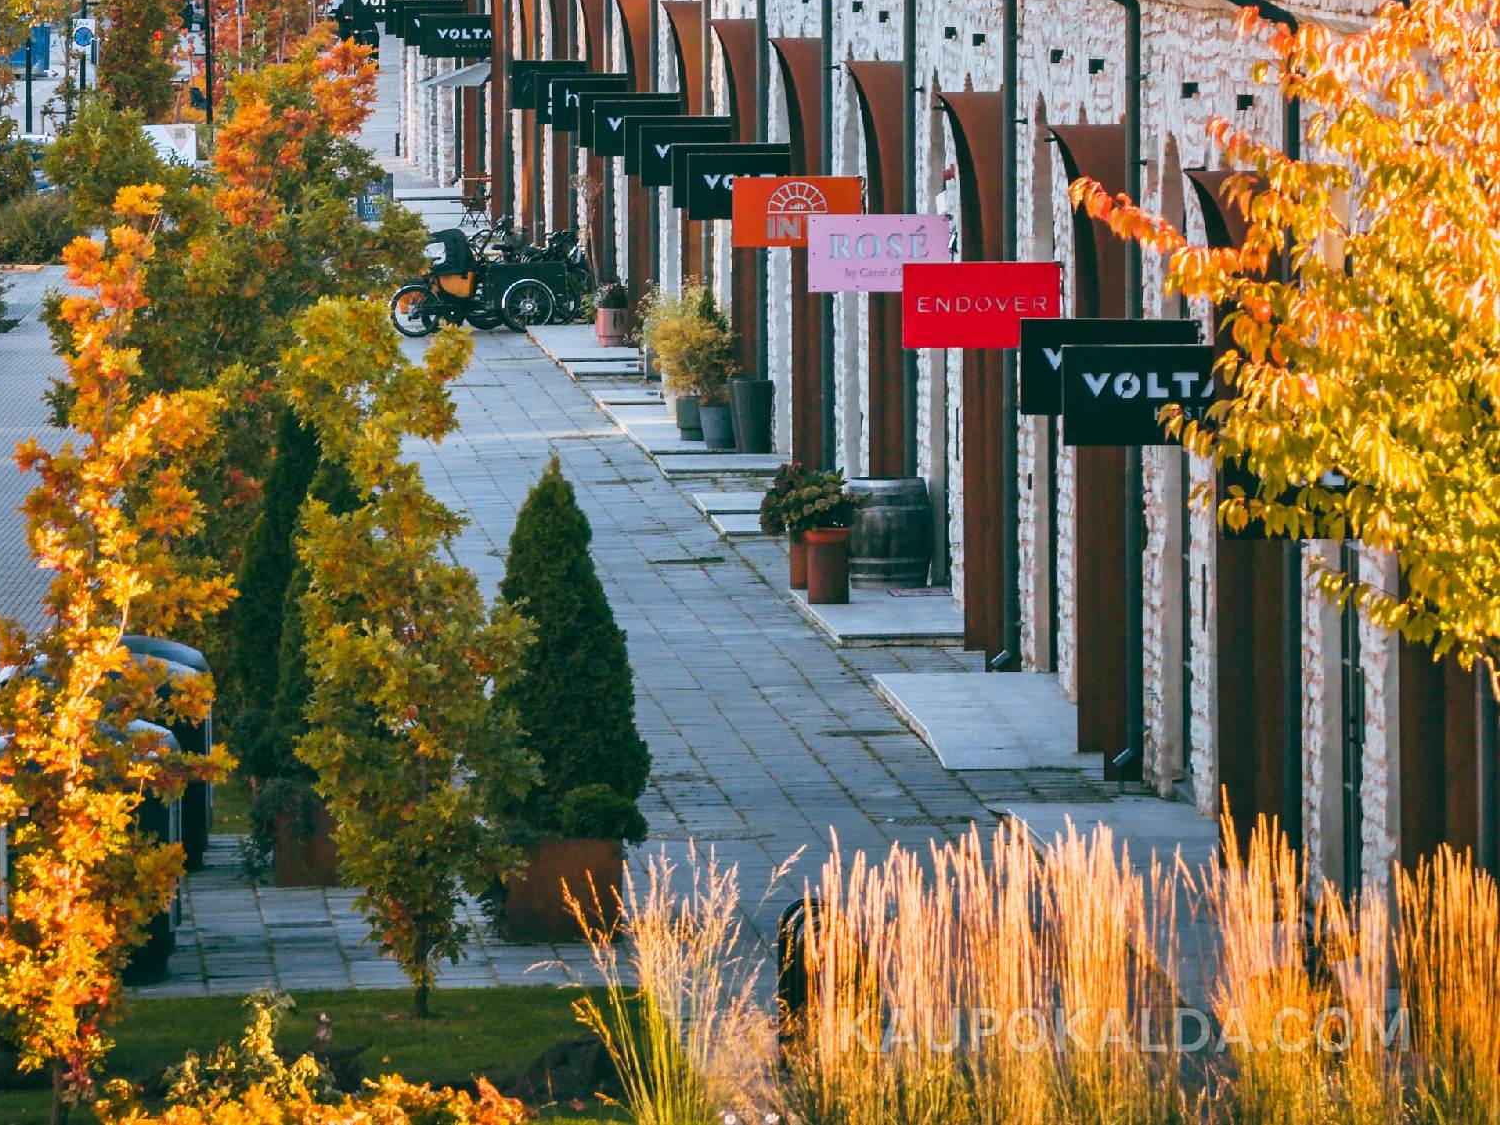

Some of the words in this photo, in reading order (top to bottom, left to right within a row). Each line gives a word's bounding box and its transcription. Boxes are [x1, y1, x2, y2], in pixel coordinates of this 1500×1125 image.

[828, 225, 930, 260] ROSÉ
[844, 267, 857, 280] by
[859, 267, 888, 278] Carré
[916, 296, 1048, 313] ENDOVER
